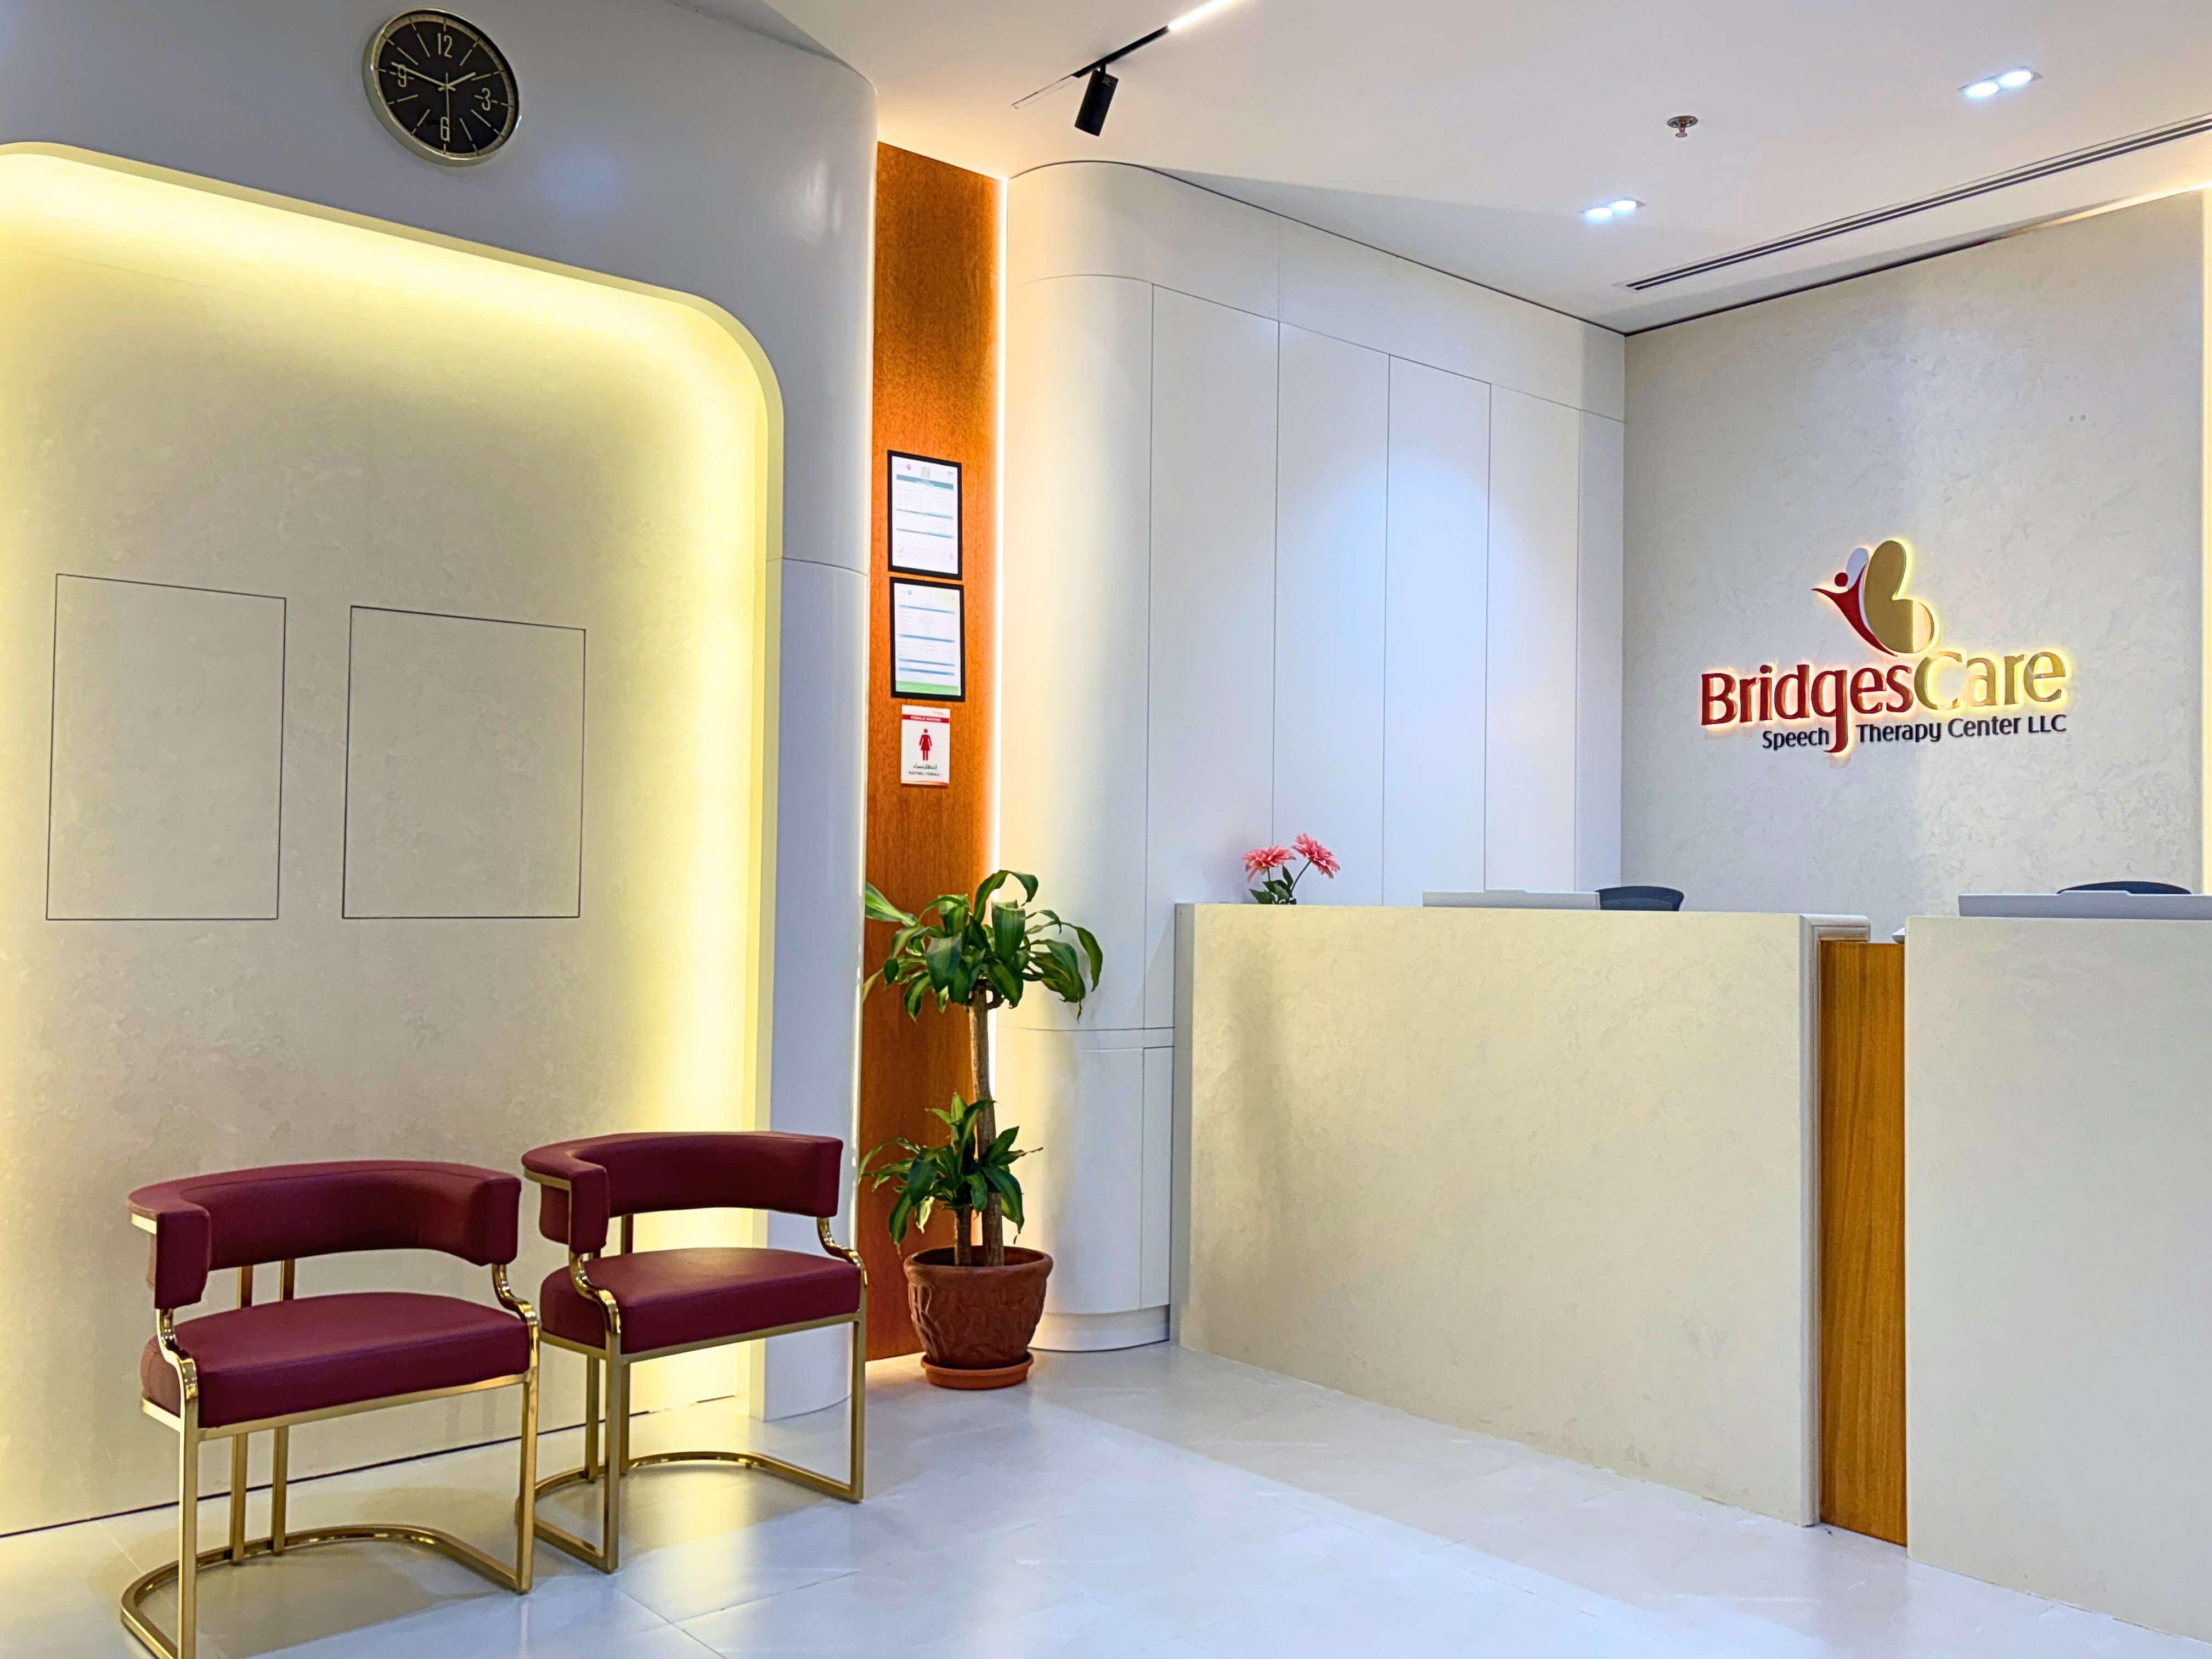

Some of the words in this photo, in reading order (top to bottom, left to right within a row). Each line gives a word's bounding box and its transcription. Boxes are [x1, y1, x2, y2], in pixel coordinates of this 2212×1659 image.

[437, 33, 453, 58] 12
[398, 64, 407, 87] 9
[481, 88, 490, 111] 3
[440, 116, 449, 141] 6
[1762, 728, 1830, 751] Speech
[1856, 722, 1942, 742] Therapy
[1948, 716, 2022, 738] Center
[2028, 714, 2067, 733] LLC
